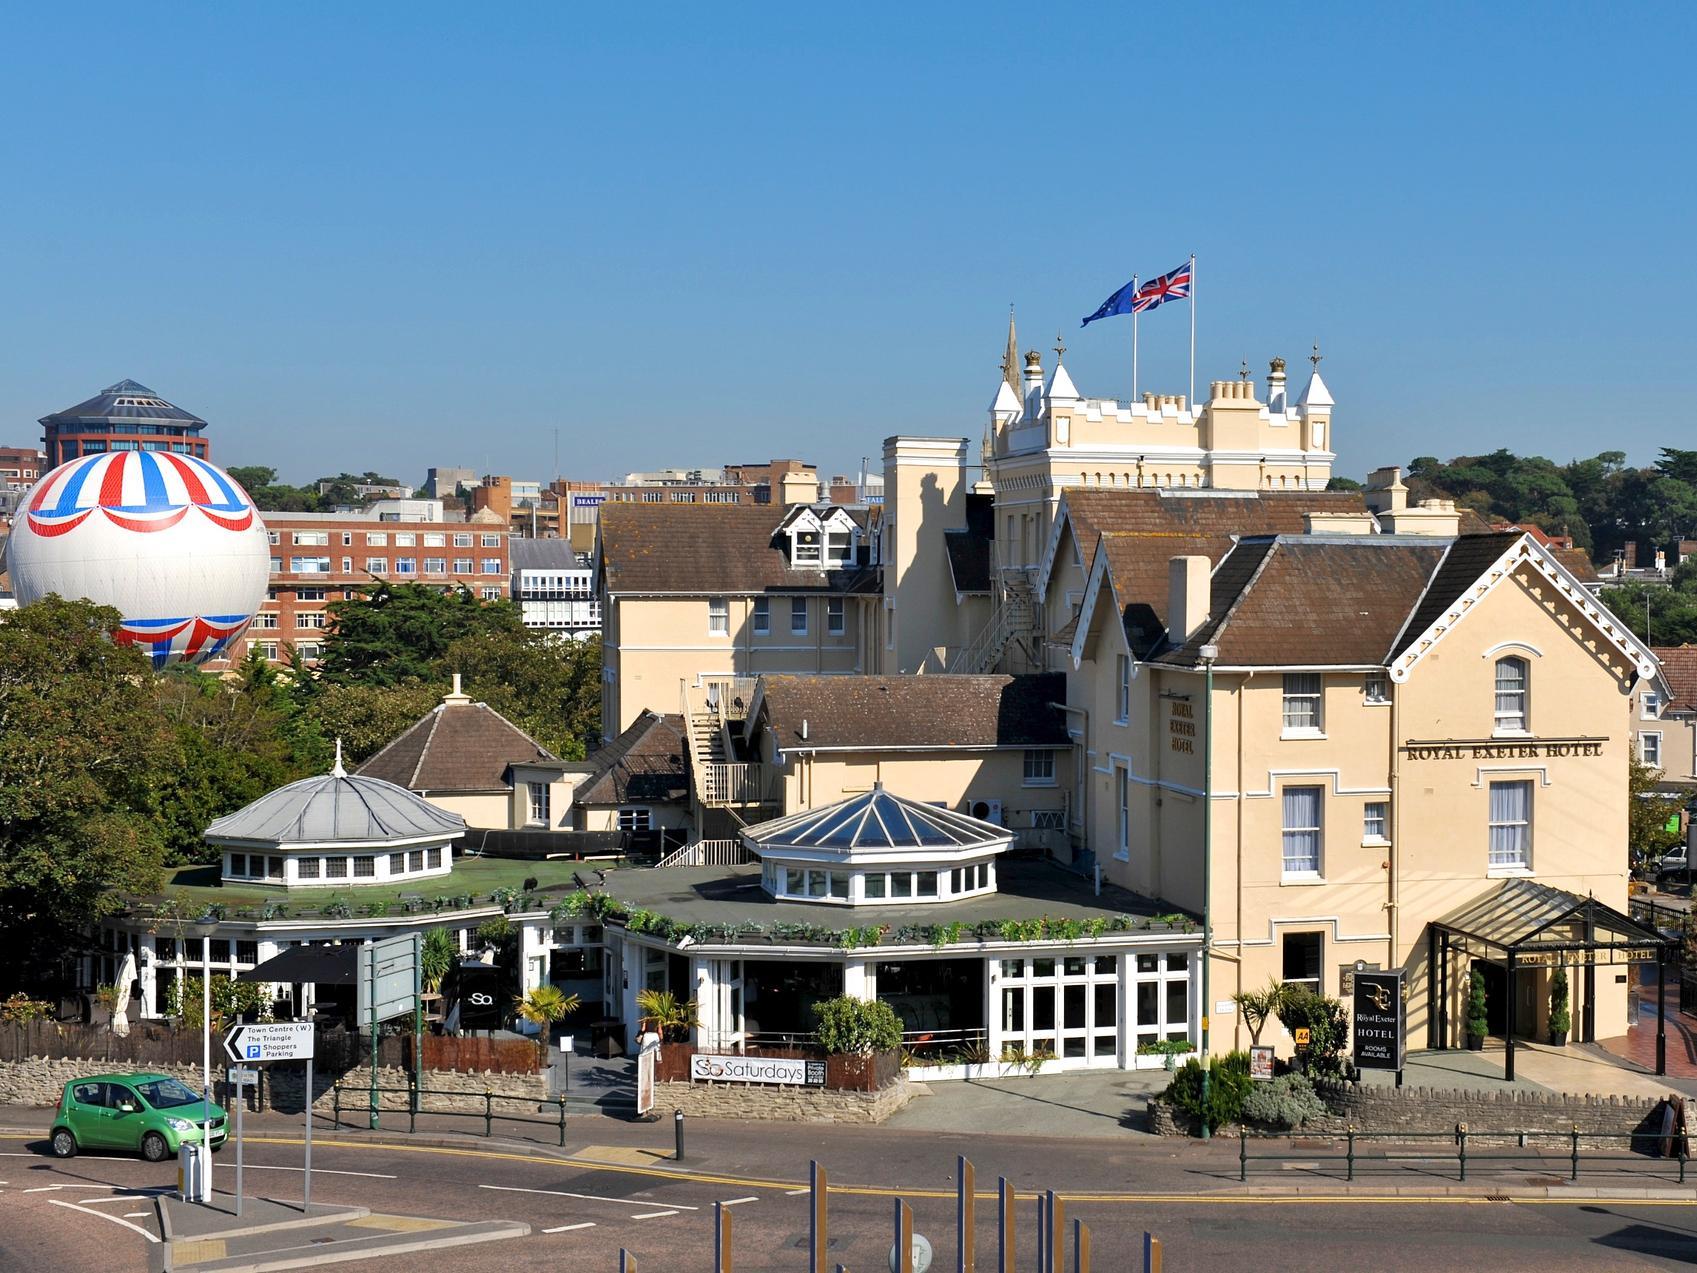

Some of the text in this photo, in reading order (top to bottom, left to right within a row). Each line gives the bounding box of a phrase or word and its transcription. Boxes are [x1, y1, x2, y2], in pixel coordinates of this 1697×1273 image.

[1171, 701, 1193, 719] ROYAL
[1170, 719, 1195, 737] EXETER
[1171, 736, 1193, 755] HOTEL
[1407, 742, 1604, 760] ROYAL EXETER HOTEL
[1521, 950, 1653, 964] ROYAL EXETER HOTEL
[1356, 1013, 1395, 1023] Royal Exeter
[295, 1024, 312, 1032] (W)
[1357, 1028, 1394, 1039] HOTEL
[1297, 1032, 1309, 1040] AA
[249, 1046, 259, 1057] P
[1364, 1045, 1387, 1053] ROOMS
[1360, 1051, 1391, 1059] AVAILABLE
[725, 1061, 803, 1082] Saturdays
